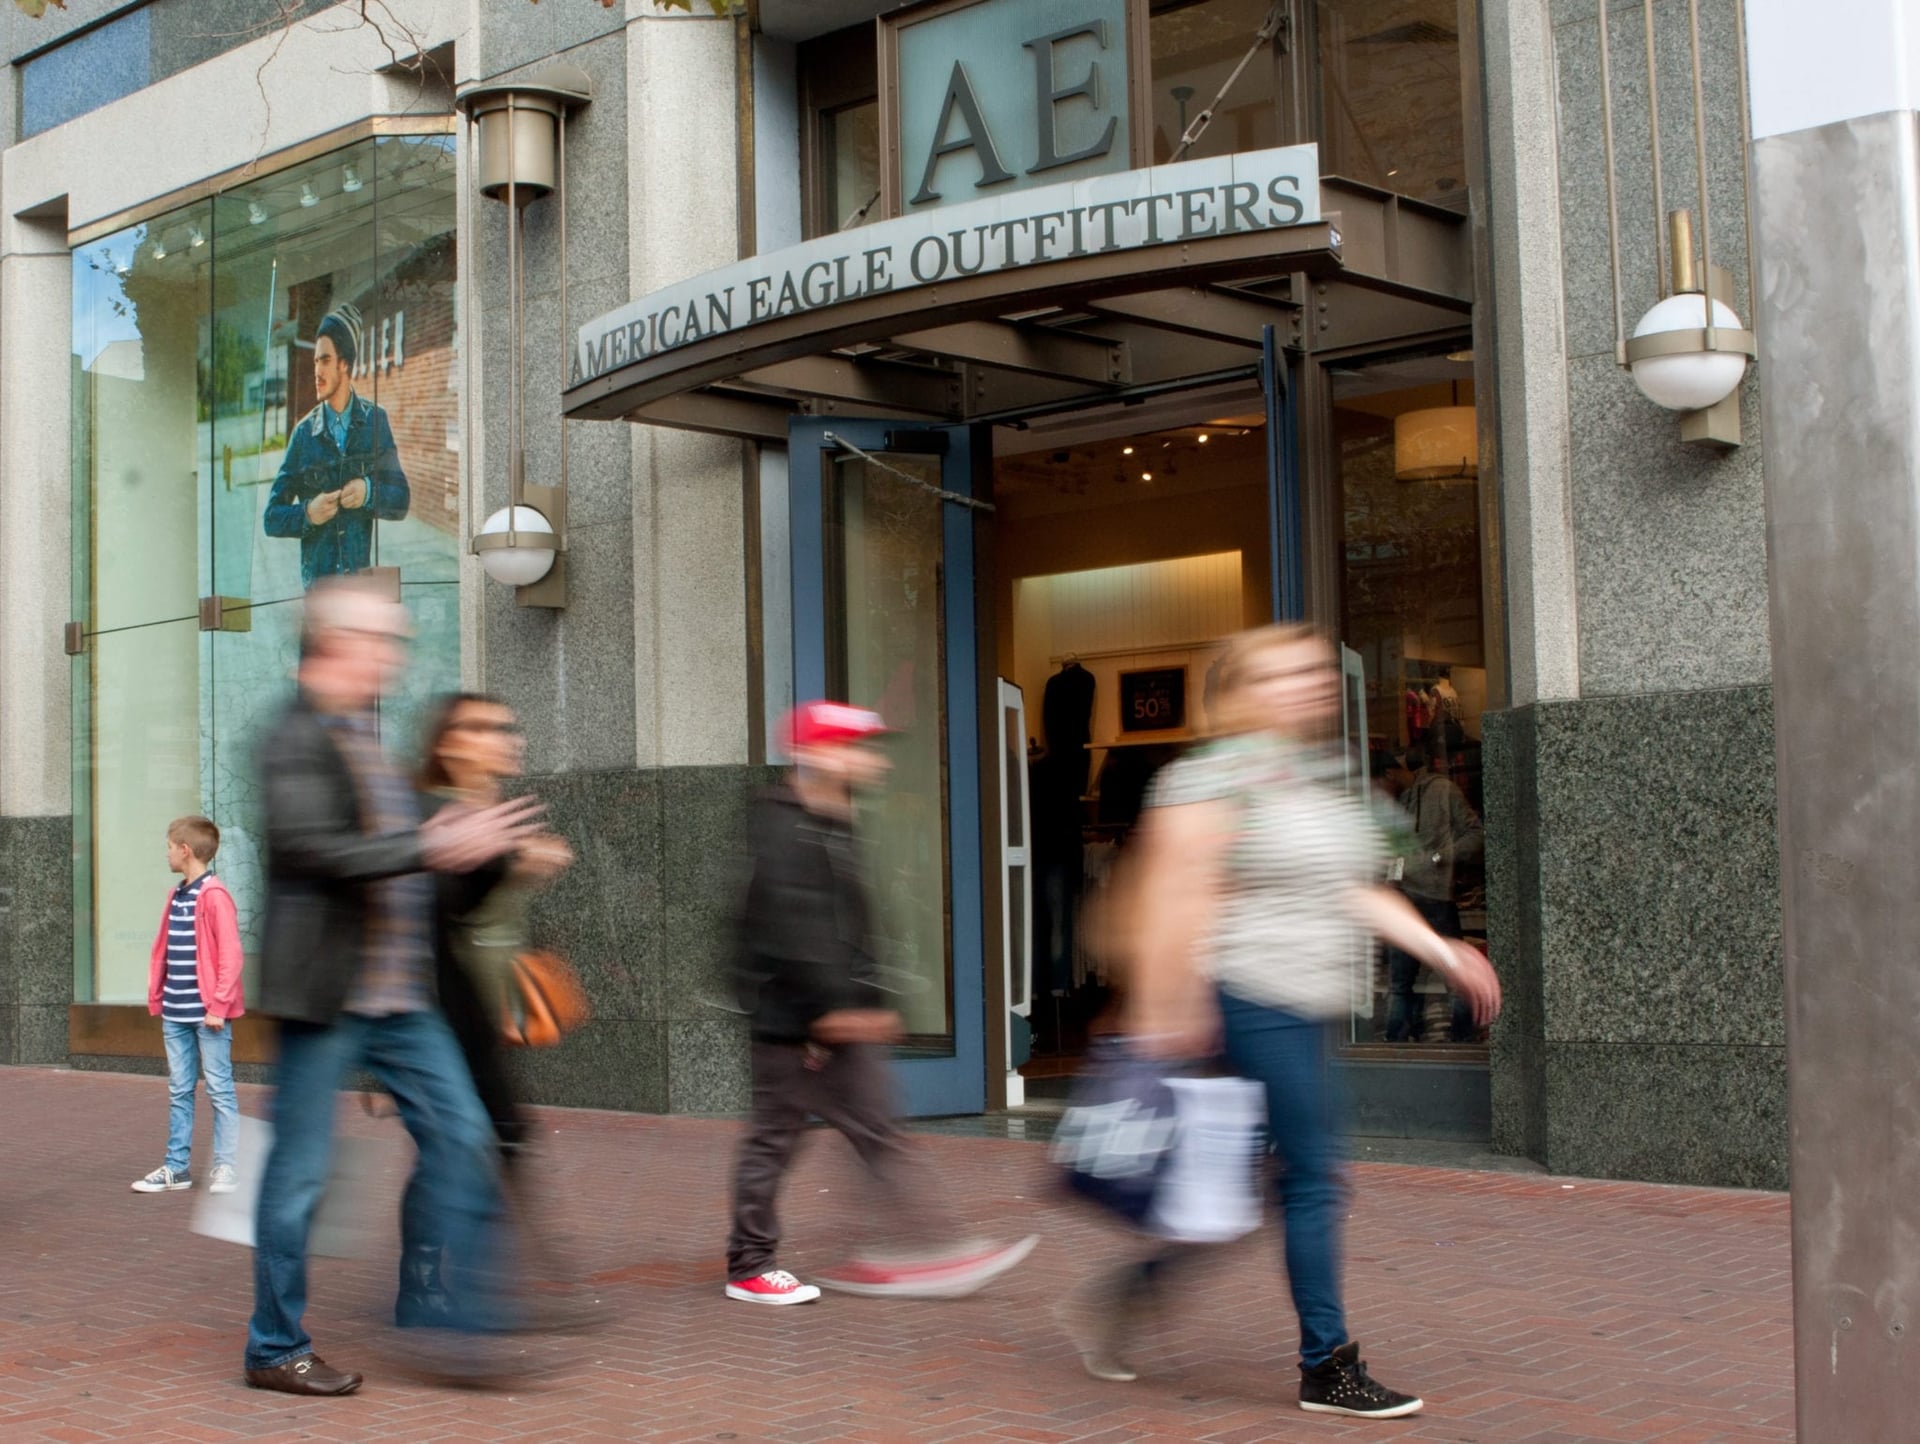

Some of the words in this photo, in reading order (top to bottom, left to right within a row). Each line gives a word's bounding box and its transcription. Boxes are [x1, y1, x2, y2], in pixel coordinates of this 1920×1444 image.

[910, 18, 1118, 206] AE
[568, 286, 735, 389] AMERICAN
[747, 246, 893, 325] EAGLE
[910, 175, 1304, 284] OUTFITTERS
